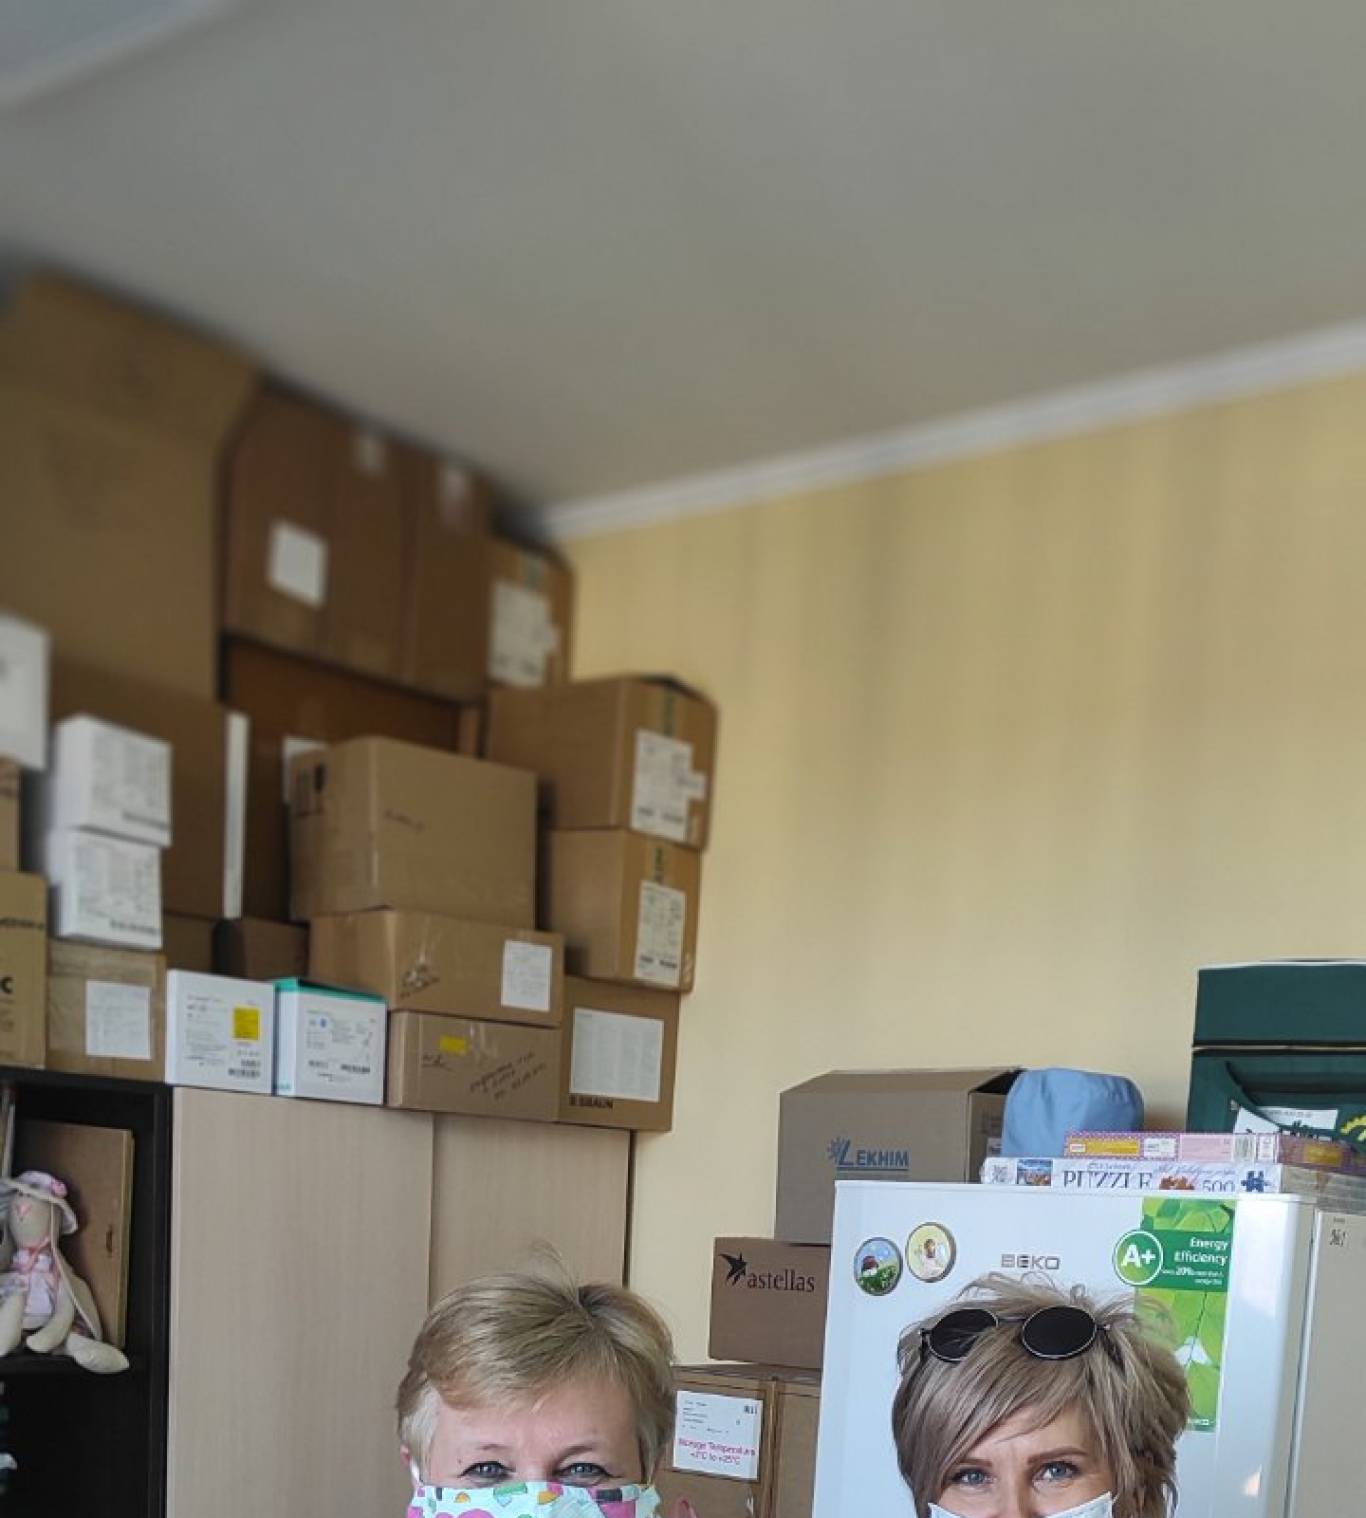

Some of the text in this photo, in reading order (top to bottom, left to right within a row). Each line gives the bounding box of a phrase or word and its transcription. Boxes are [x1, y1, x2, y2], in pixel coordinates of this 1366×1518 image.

[838, 1138, 910, 1167] LEKHIM
[1189, 1237, 1229, 1250] Energy
[1001, 1254, 1061, 1270] BEKO
[1120, 1244, 1157, 1269] A+
[1174, 1252, 1229, 1266] Efficiency
[746, 1268, 816, 1293] astellas
